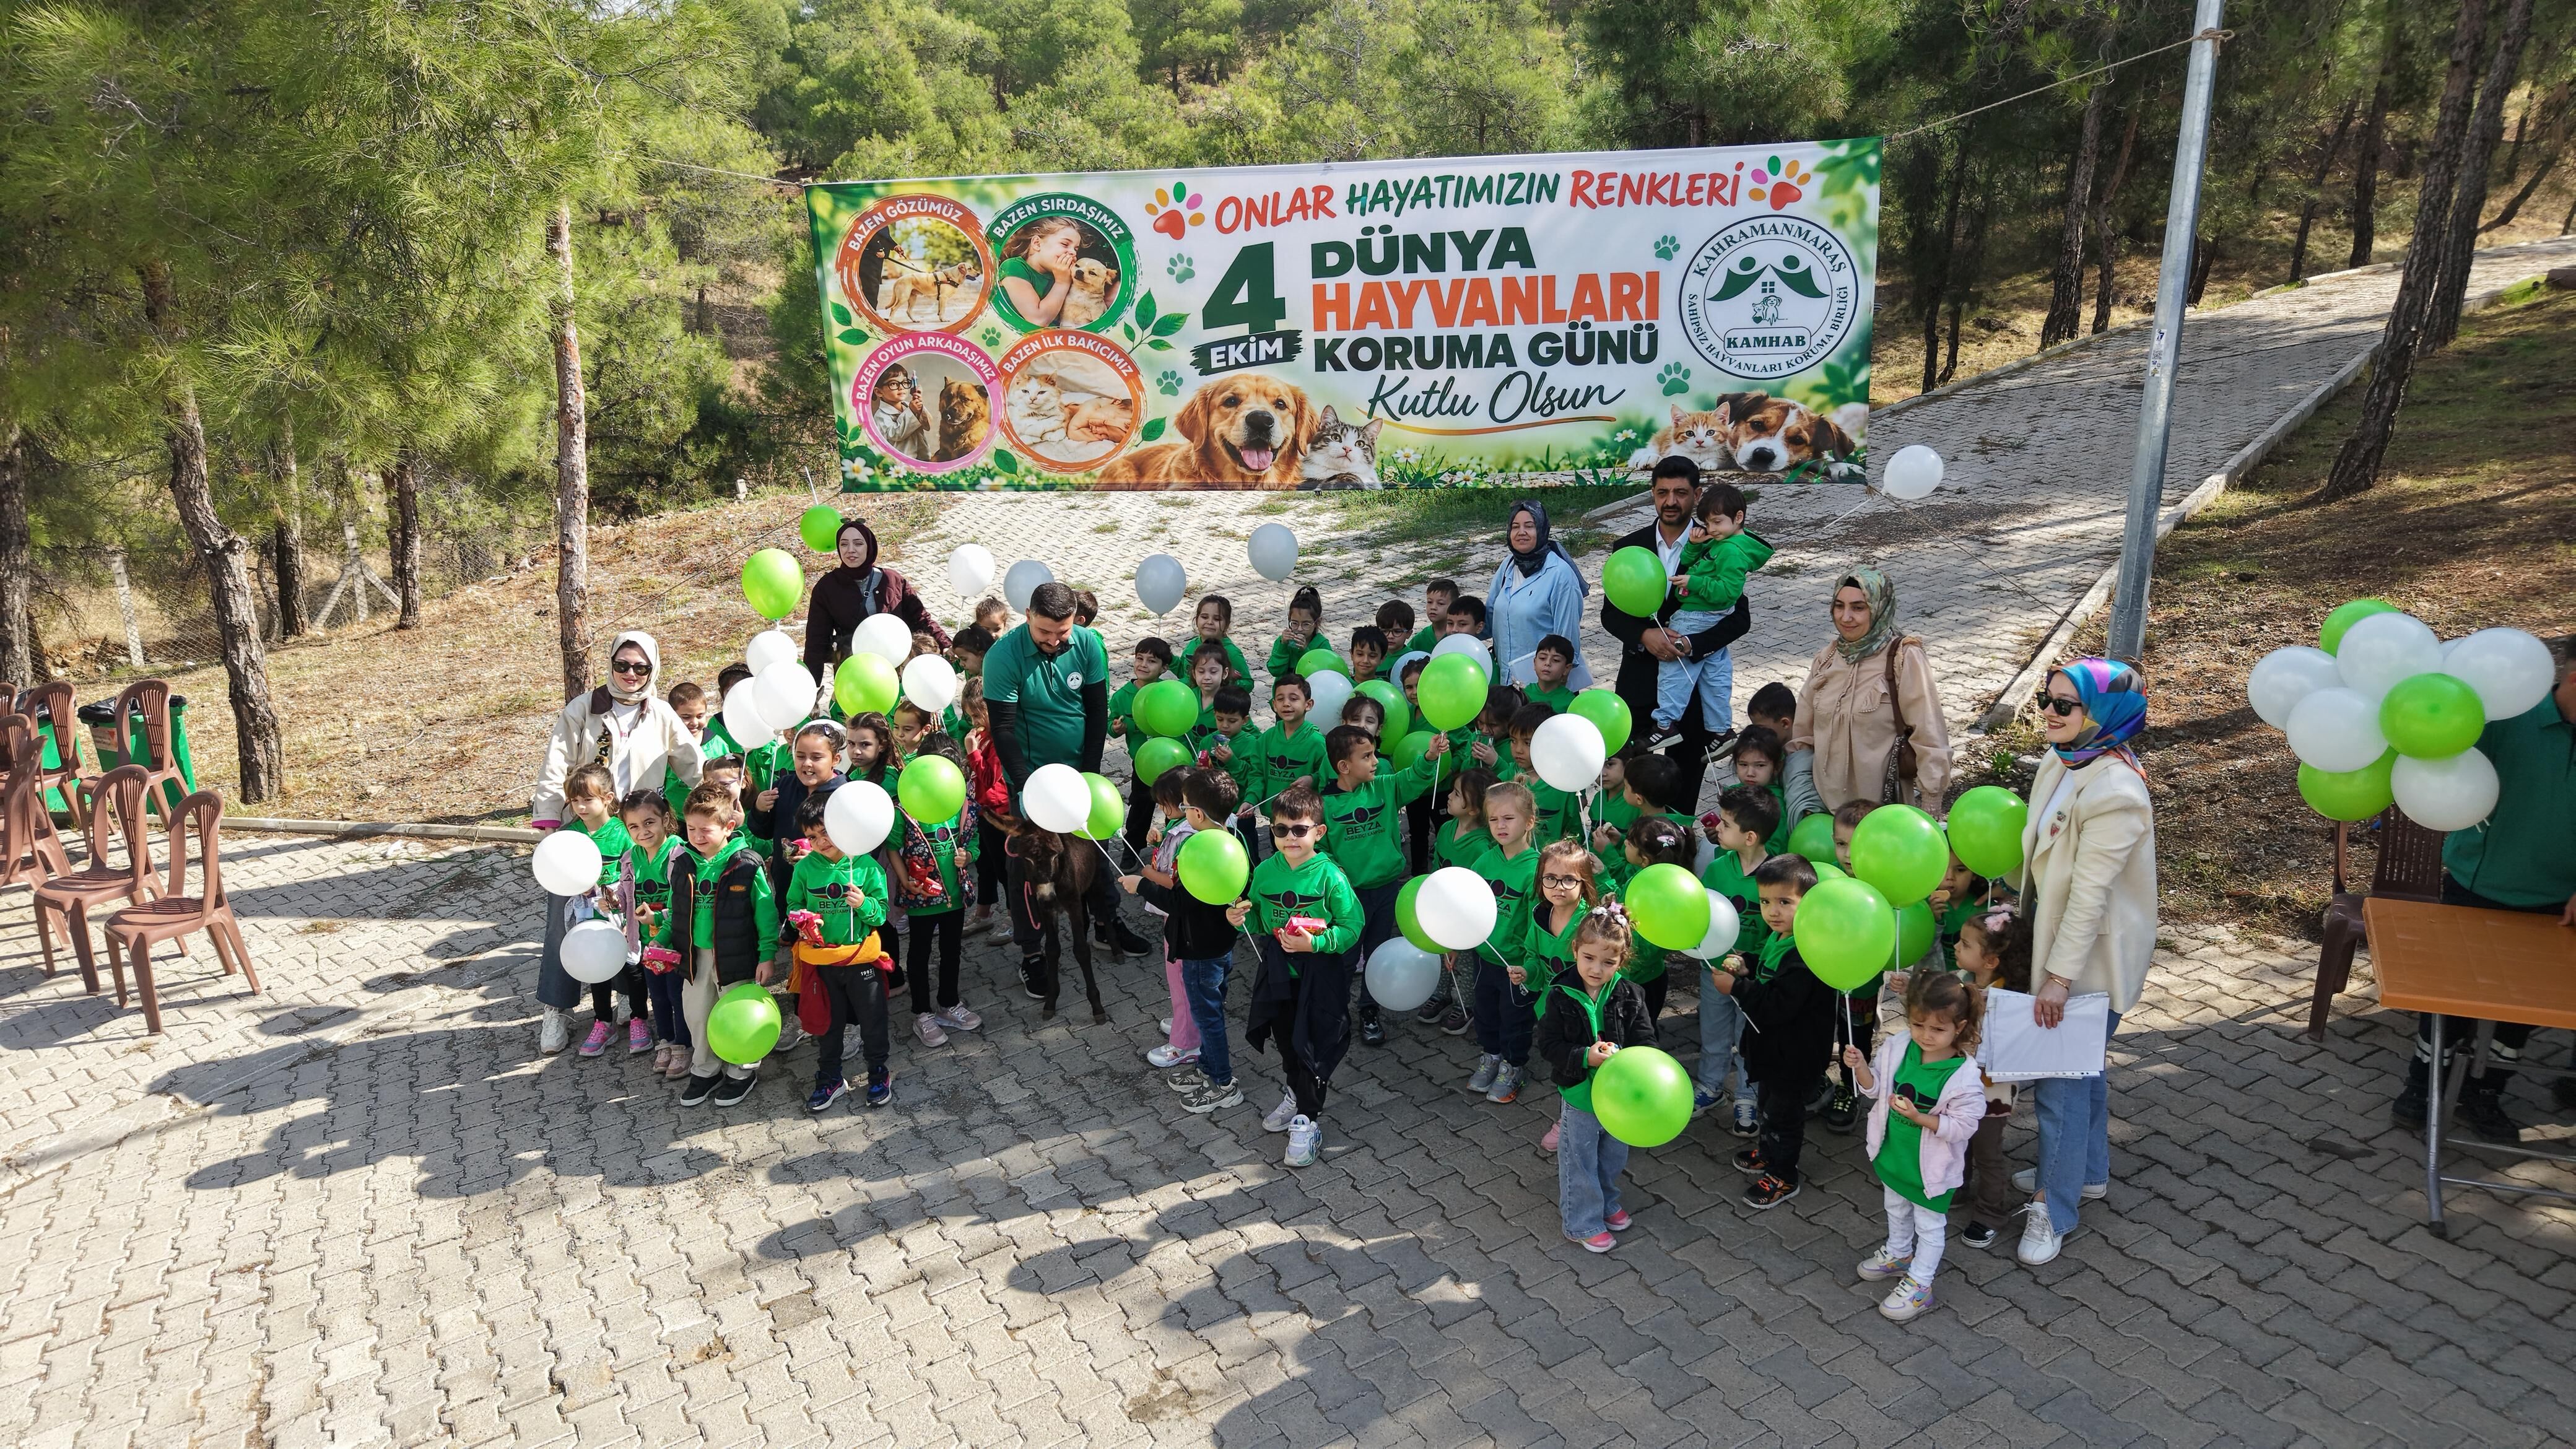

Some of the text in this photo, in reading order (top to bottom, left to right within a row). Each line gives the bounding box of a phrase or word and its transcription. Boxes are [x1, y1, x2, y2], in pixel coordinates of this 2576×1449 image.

[848, 198, 964, 251] BAZEN GÖZÜMÜZ
[992, 198, 1125, 240] BAZEN SIRDAŞIMIZ
[1214, 161, 1744, 235] ONLAR HAYATIMIZIN RENKLERİ
[1311, 224, 1537, 279] DÜNYA
[1692, 222, 1847, 278] KAHRAMANMARAŞ
[1201, 241, 1286, 335] 4
[1312, 271, 1660, 332] HAYVANLARI
[1003, 334, 1134, 377] BAZEN İLK BAKICIMIZ
[1210, 336, 1284, 369] EKİM
[1314, 320, 1658, 372] KORUMA GÜNÜ
[1687, 285, 1848, 373] SAHİPSİZ HAYVANLARI KORUMA BİRLİĞİ
[1726, 335, 1806, 349] KAMHAB
[856, 336, 996, 401] BAZEN OYUN ARKADAŞIMIZ
[1367, 370, 1626, 424] Kutlu Olsun
[1270, 768, 1296, 778] BEYZA
[1346, 821, 1382, 835] BEYZA
